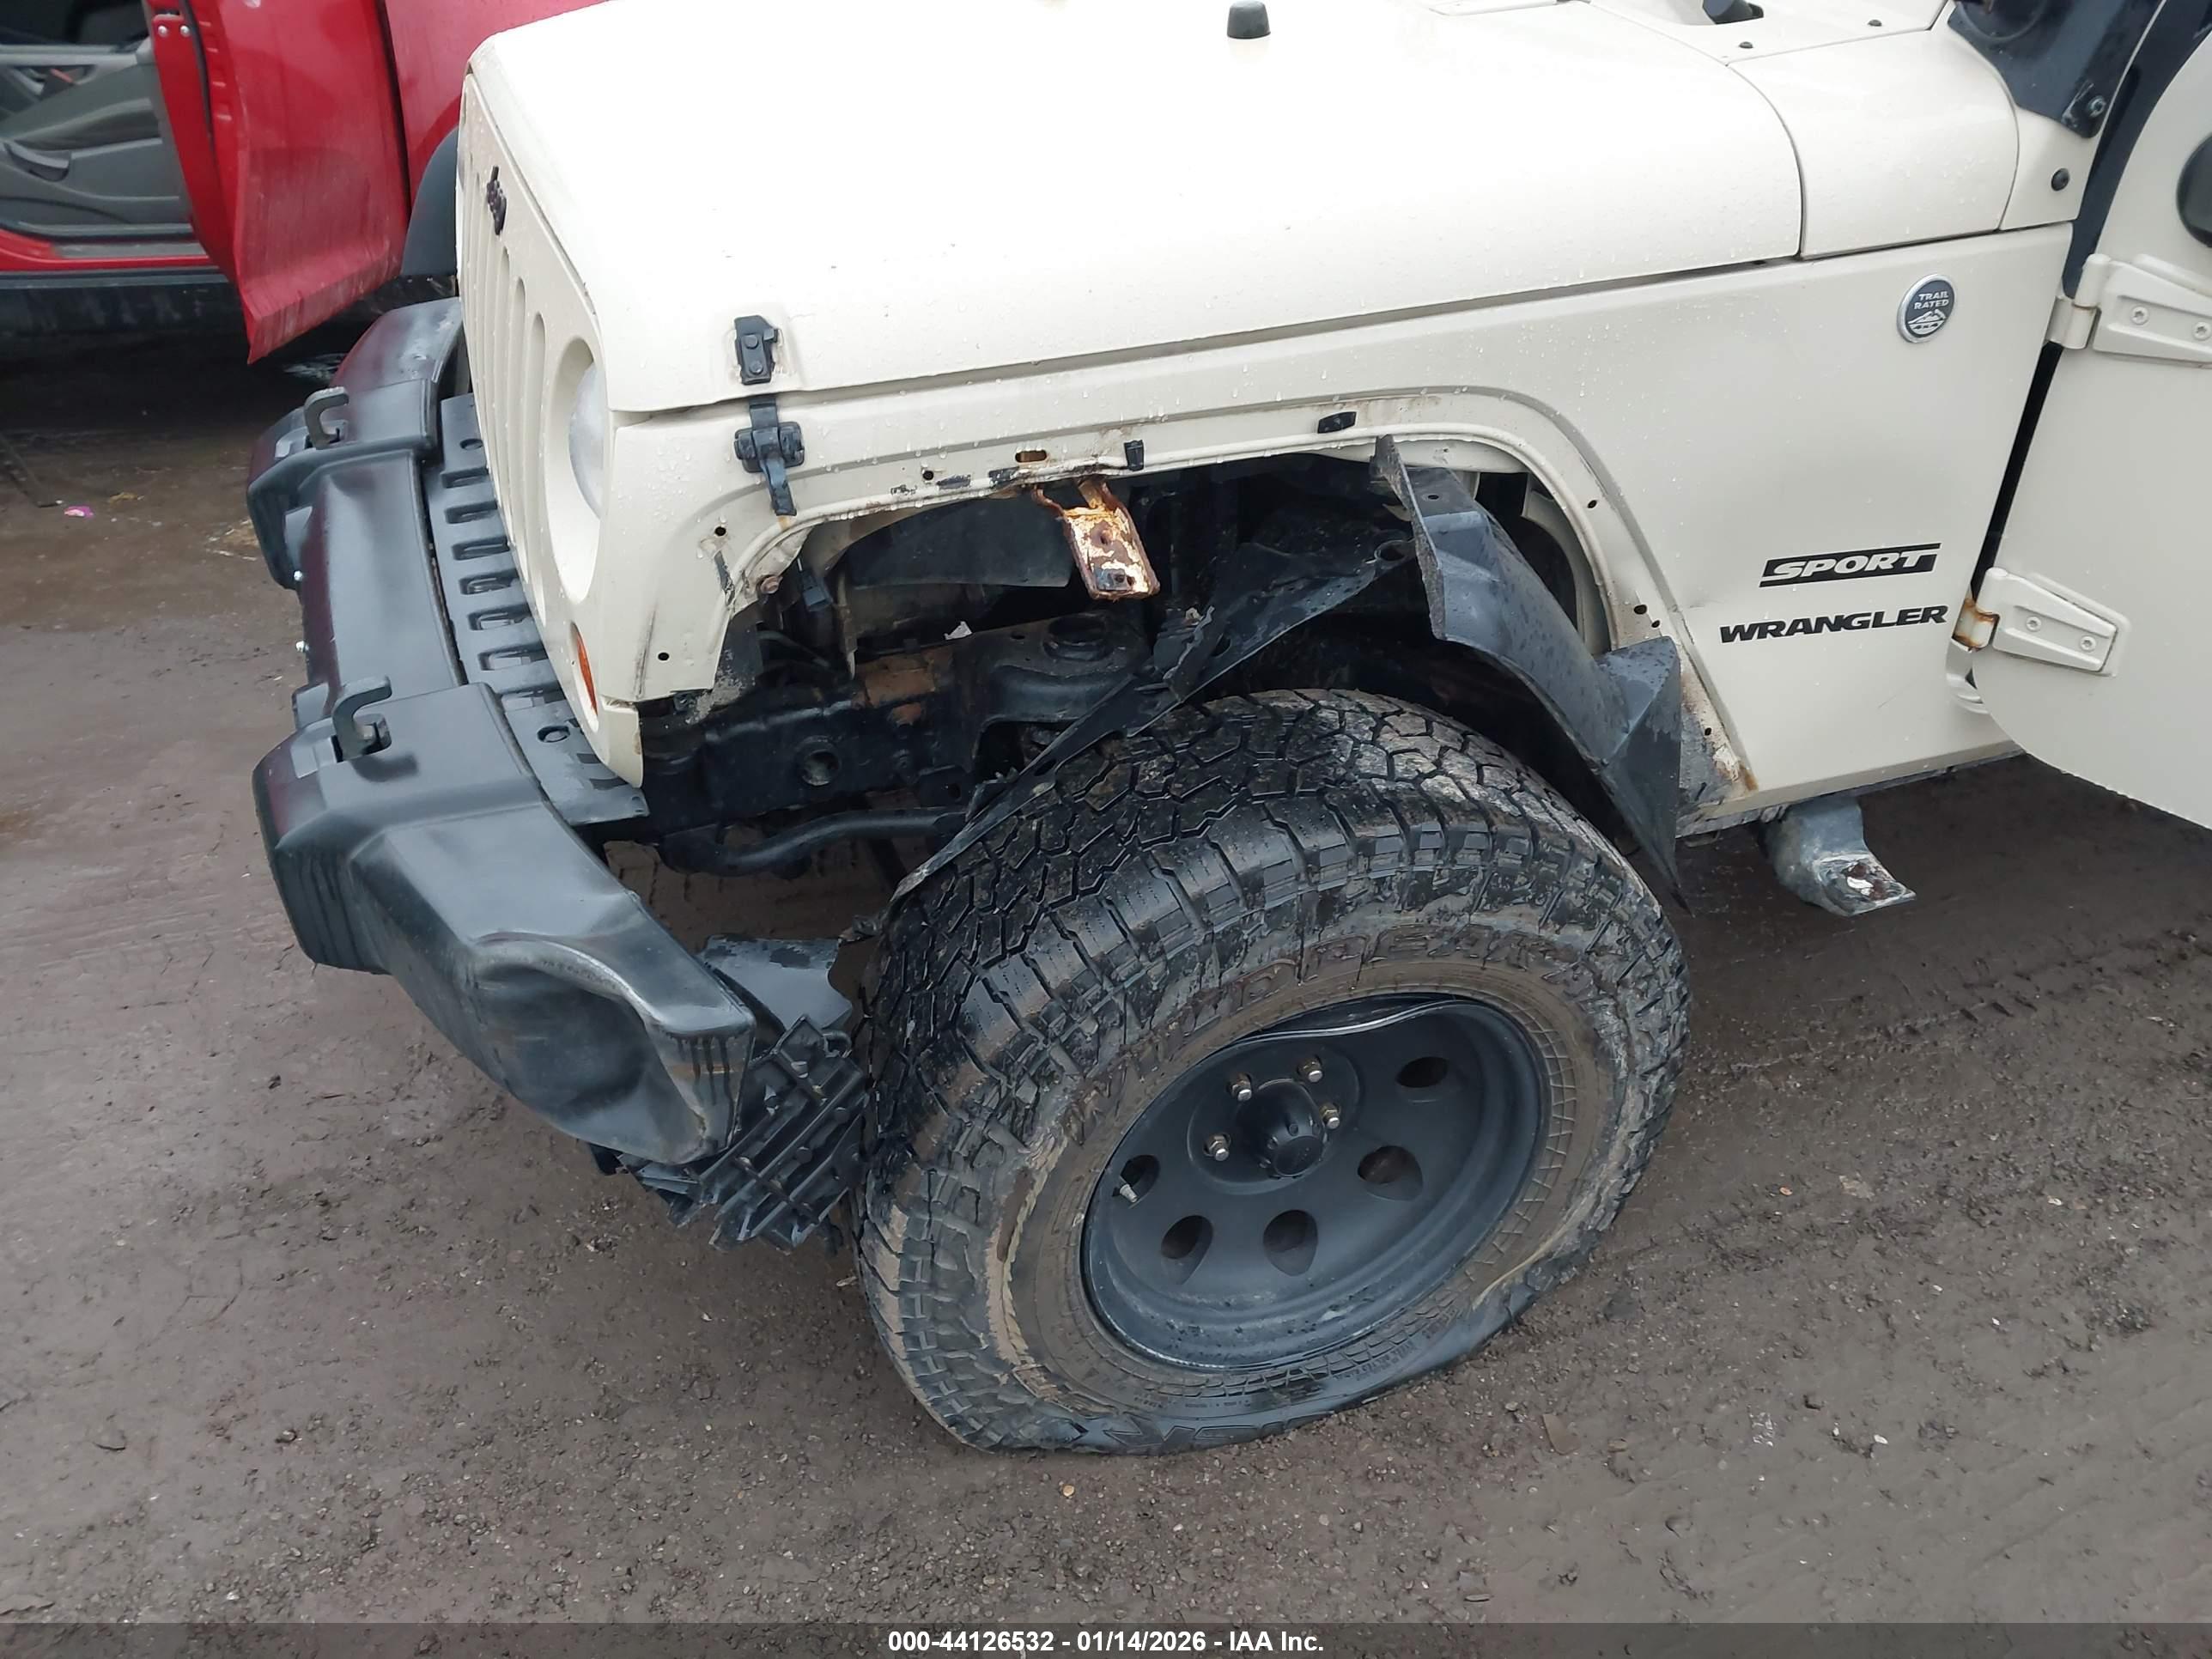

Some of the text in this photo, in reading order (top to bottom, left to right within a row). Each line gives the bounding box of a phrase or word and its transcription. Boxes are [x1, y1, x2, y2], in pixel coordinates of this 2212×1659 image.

[1914, 300, 1949, 309] RATED
[1918, 291, 1949, 301] TRAIL
[1770, 550, 1933, 580] SPORT
[1720, 605, 1948, 643] WRANGLER
